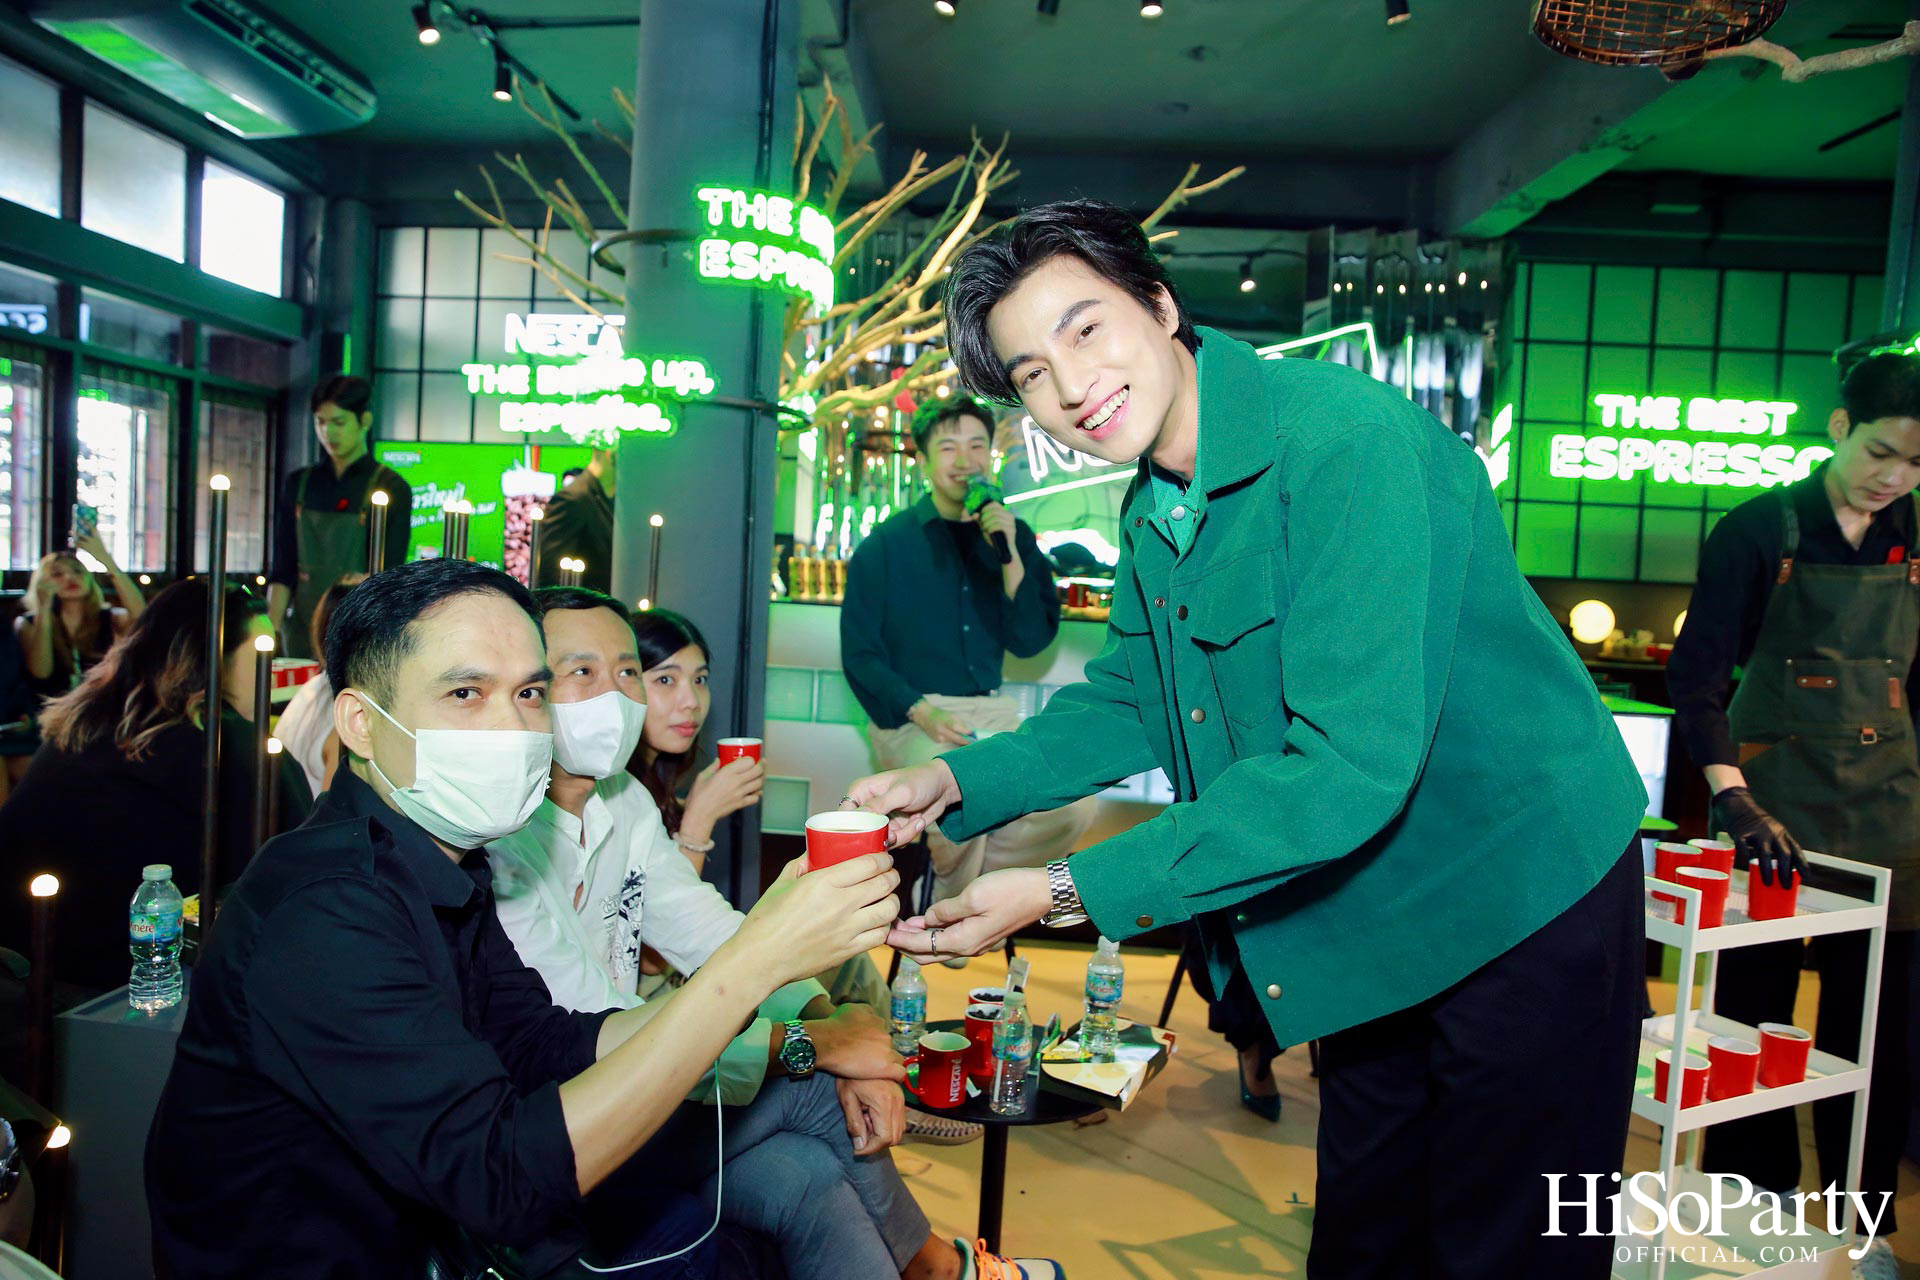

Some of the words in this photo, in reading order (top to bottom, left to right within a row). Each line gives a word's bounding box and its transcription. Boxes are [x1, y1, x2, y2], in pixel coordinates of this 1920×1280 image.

[698, 188, 793, 236] THE
[505, 313, 626, 357] NESCA
[462, 364, 530, 394] THE
[1594, 393, 1682, 430] THE
[1688, 398, 1798, 436] BEST
